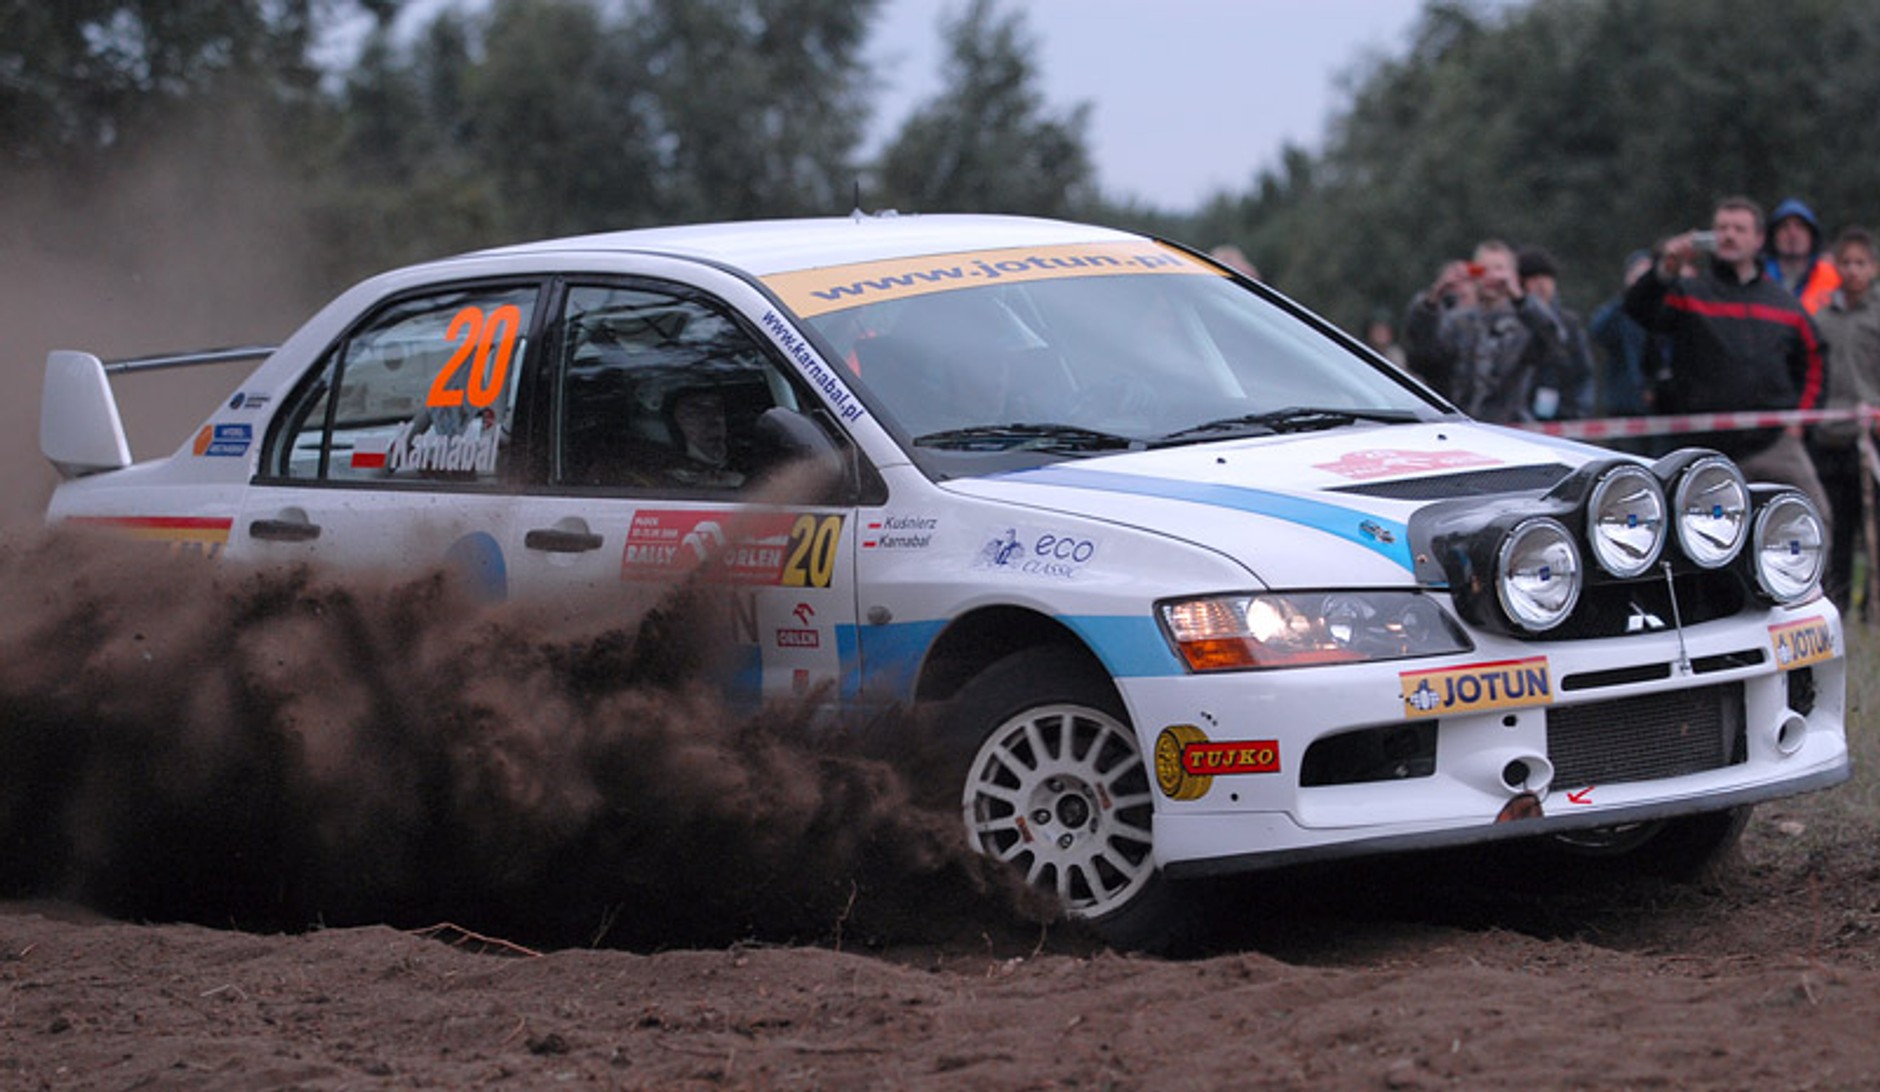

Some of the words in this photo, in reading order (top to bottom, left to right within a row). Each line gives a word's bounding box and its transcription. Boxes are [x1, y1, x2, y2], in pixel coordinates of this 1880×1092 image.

[810, 252, 1185, 301] www.jotun.pl
[425, 303, 521, 408] 20
[762, 310, 865, 422] www.karnabal.pl
[883, 515, 938, 530] Kuśnierz
[624, 544, 677, 565] RALLY
[723, 547, 782, 567] ORLEN
[782, 513, 843, 588] 20
[1034, 533, 1095, 563] eco
[1443, 667, 1550, 707] JOTUN
[1190, 748, 1275, 768] TUJKO
